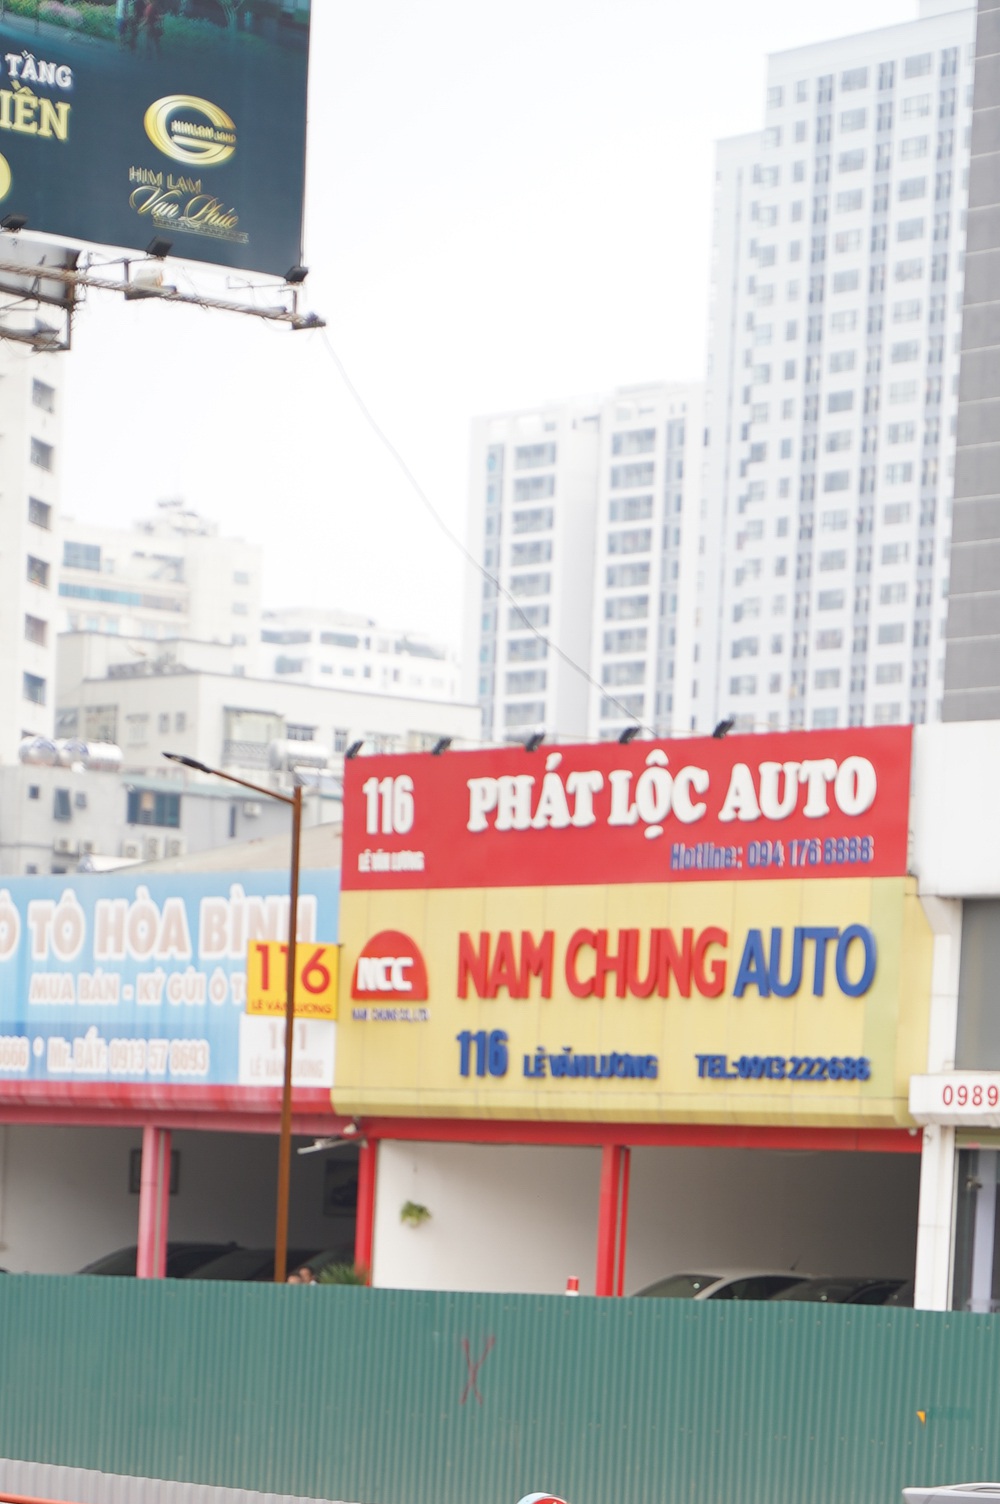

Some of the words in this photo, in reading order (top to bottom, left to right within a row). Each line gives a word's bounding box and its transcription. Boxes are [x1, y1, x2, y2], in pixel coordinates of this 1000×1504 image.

[5, 50, 72, 88] TẦNG
[129, 166, 163, 187] HIM
[167, 174, 203, 194] LAM
[362, 774, 415, 835] 116
[466, 752, 604, 833] PHÁT
[607, 748, 710, 840] LỘC
[718, 755, 877, 822] AUTO
[671, 841, 743, 871] Hotline:
[747, 839, 784, 869] 094
[789, 837, 822, 868] 176
[824, 835, 875, 864] 8888
[28, 888, 86, 962] TÔ
[94, 885, 192, 961] HÒA
[357, 956, 414, 991] NCC
[457, 930, 555, 999] NAM
[565, 926, 728, 999] CHUNG
[733, 924, 878, 998] AUTO
[29, 973, 75, 1005] MUA
[456, 1029, 509, 1078] 116
[943, 1085, 999, 1106] 0989
